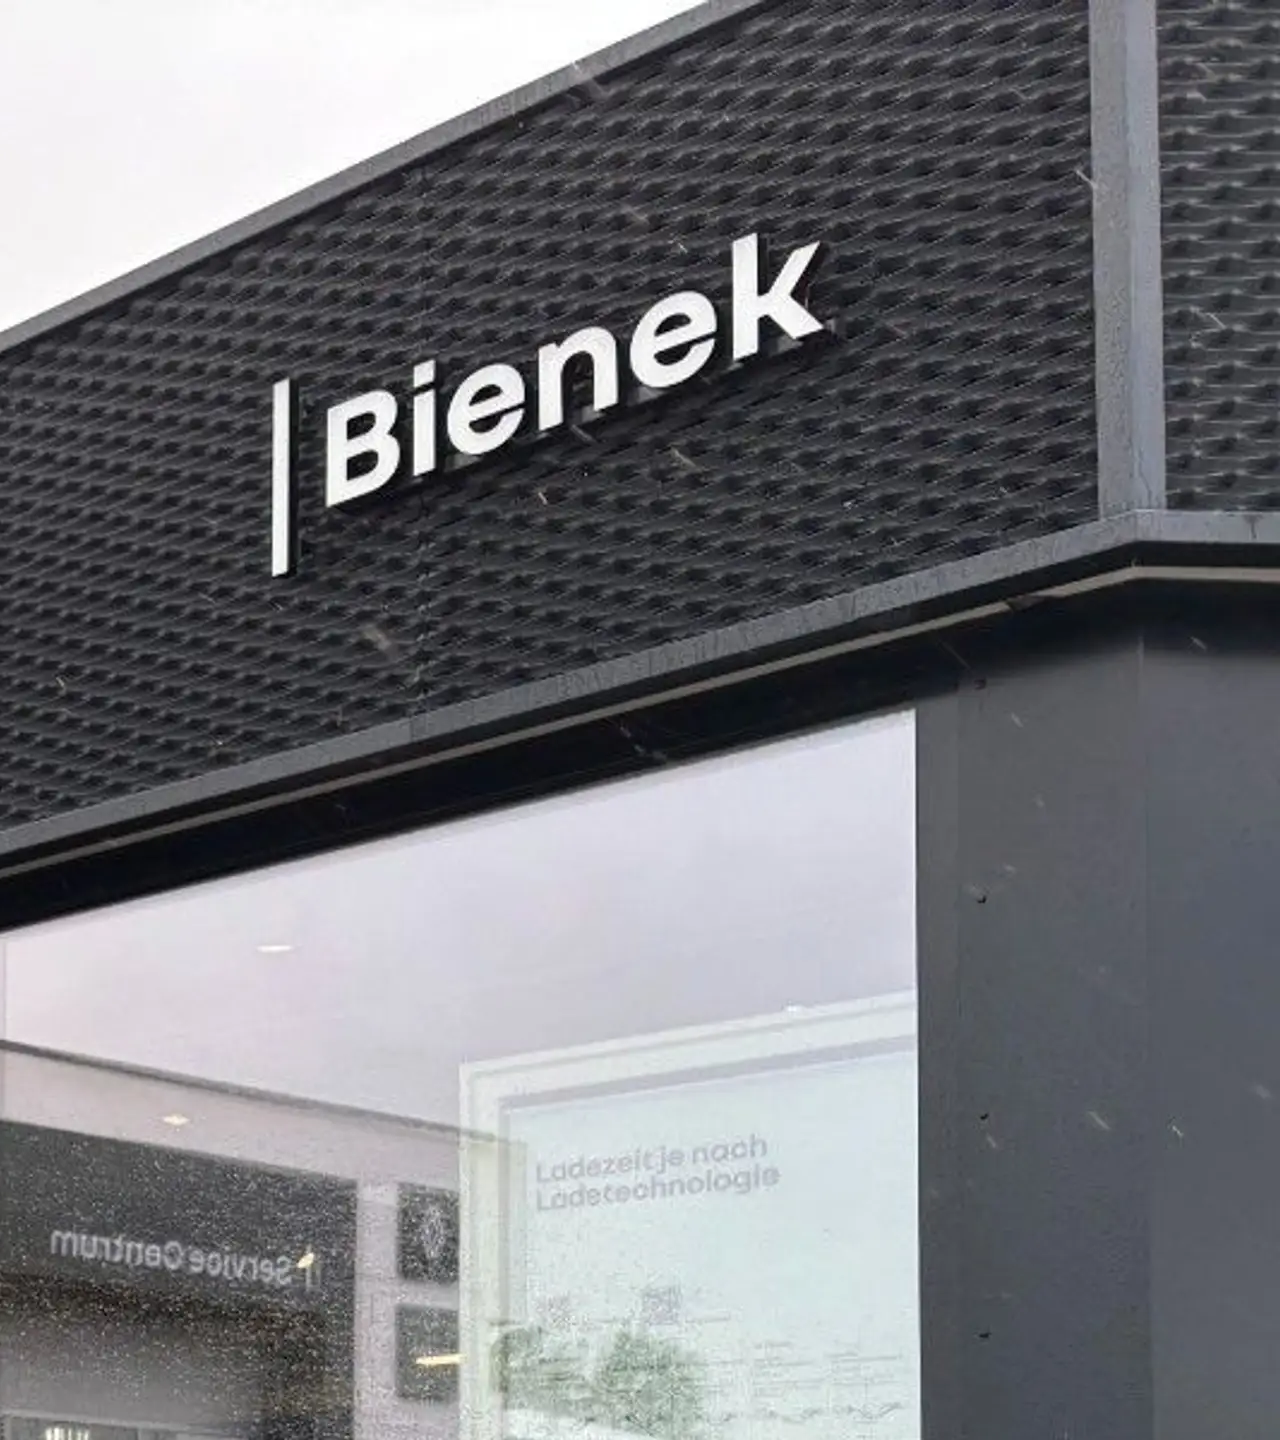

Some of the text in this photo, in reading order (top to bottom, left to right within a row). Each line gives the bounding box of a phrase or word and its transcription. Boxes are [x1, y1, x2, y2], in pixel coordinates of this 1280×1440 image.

[325, 232, 825, 508] Bienek
[536, 1133, 768, 1184] Ladezeit je nach
[536, 1164, 781, 1211] Ladetechnologie
